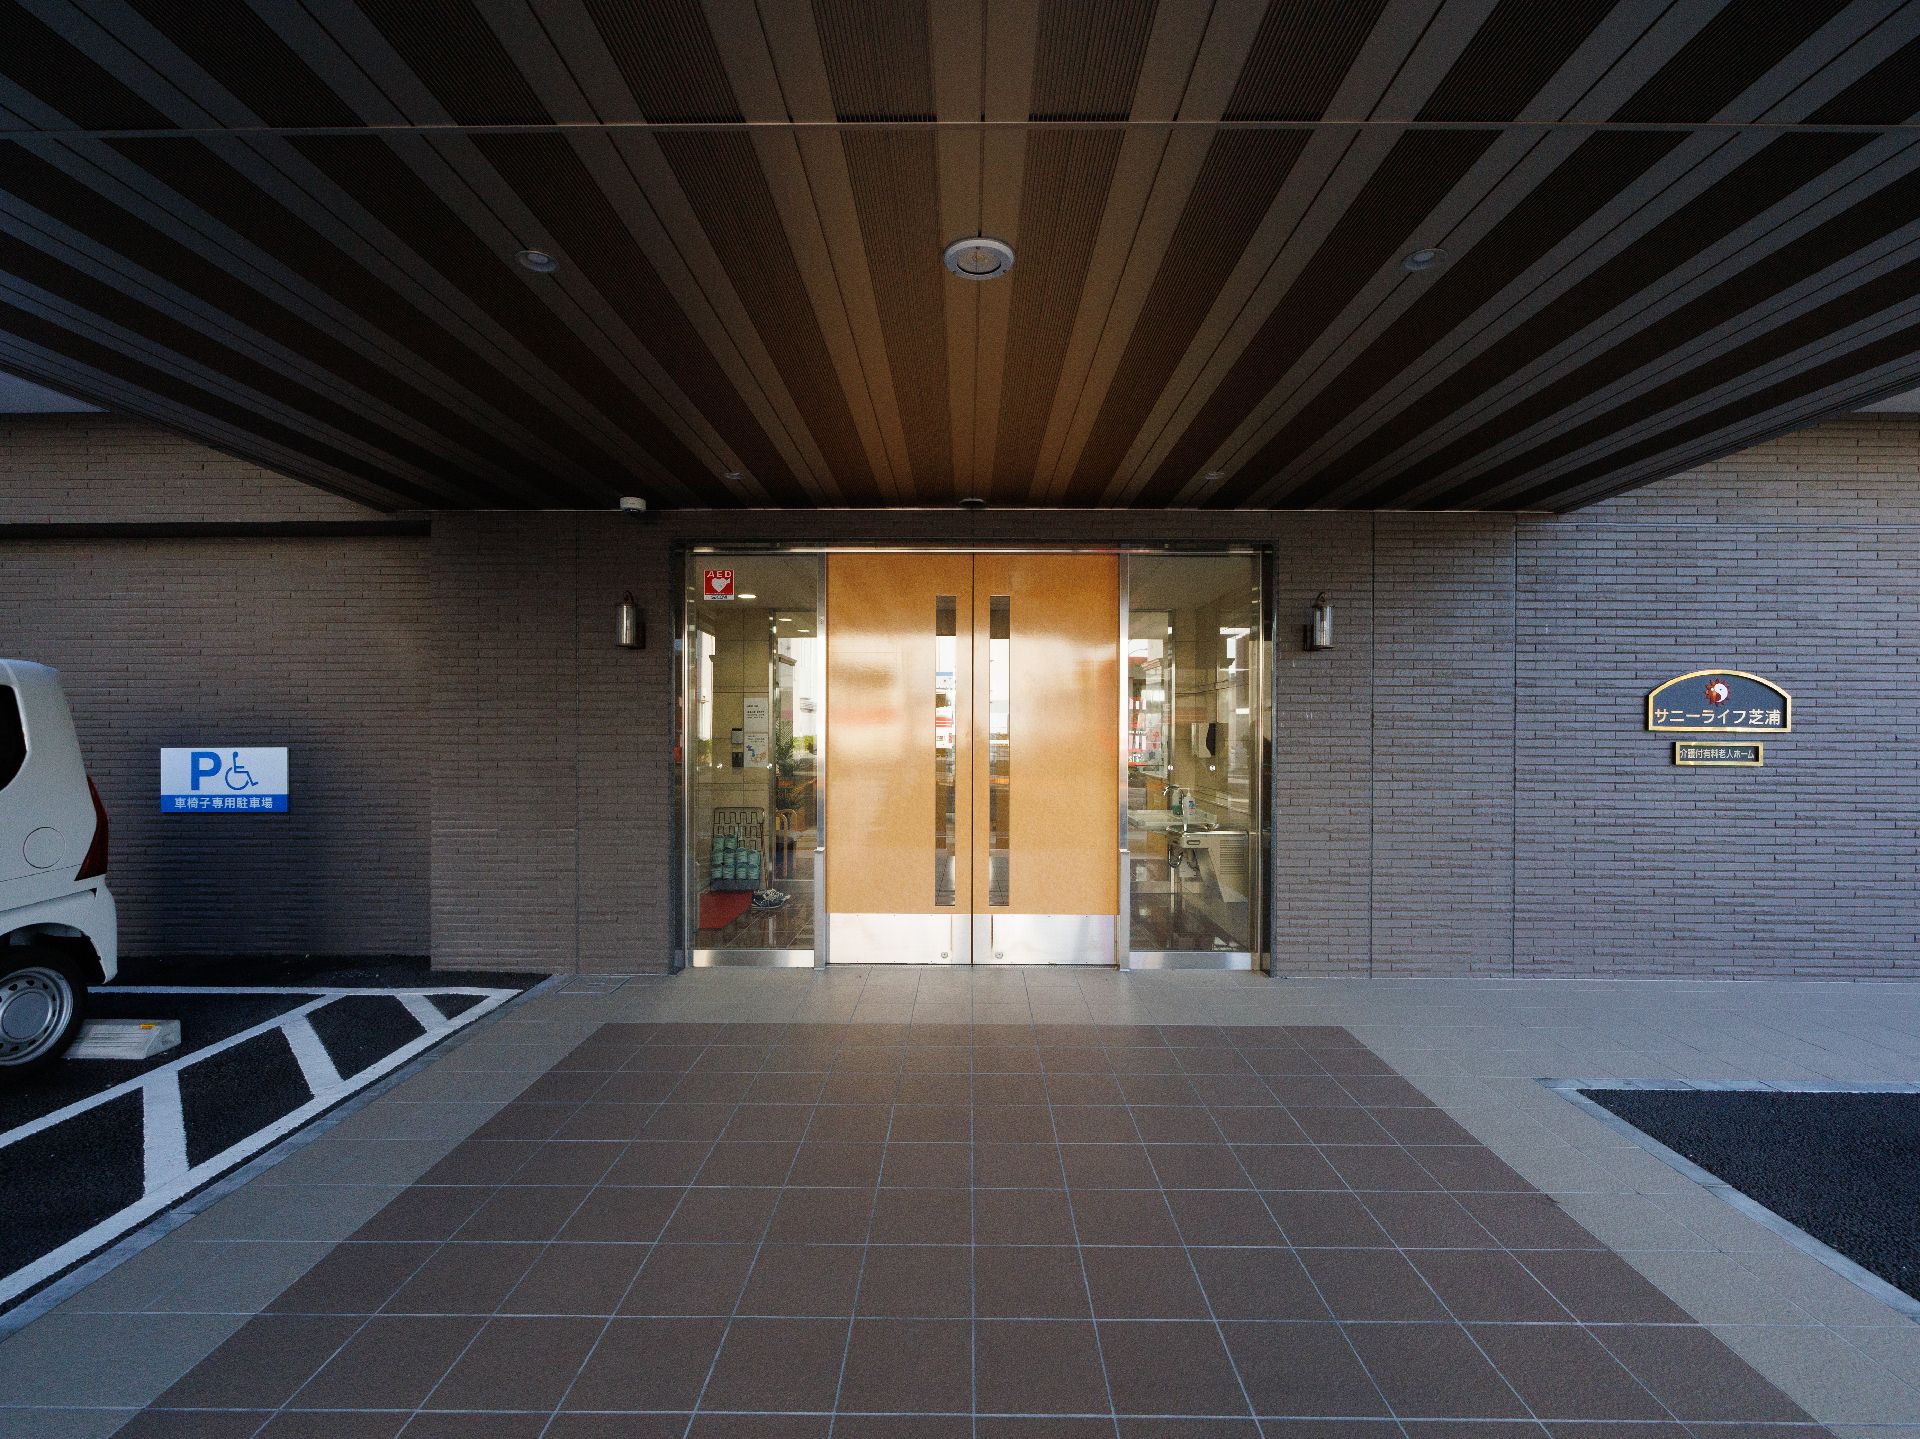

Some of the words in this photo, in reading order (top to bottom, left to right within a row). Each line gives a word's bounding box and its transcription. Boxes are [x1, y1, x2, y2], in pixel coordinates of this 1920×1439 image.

[706, 570, 732, 578] AED
[1655, 709, 1781, 725] サニーライフ芝浦
[191, 752, 222, 791] P
[175, 797, 273, 809] 車椅子専用駐車場
